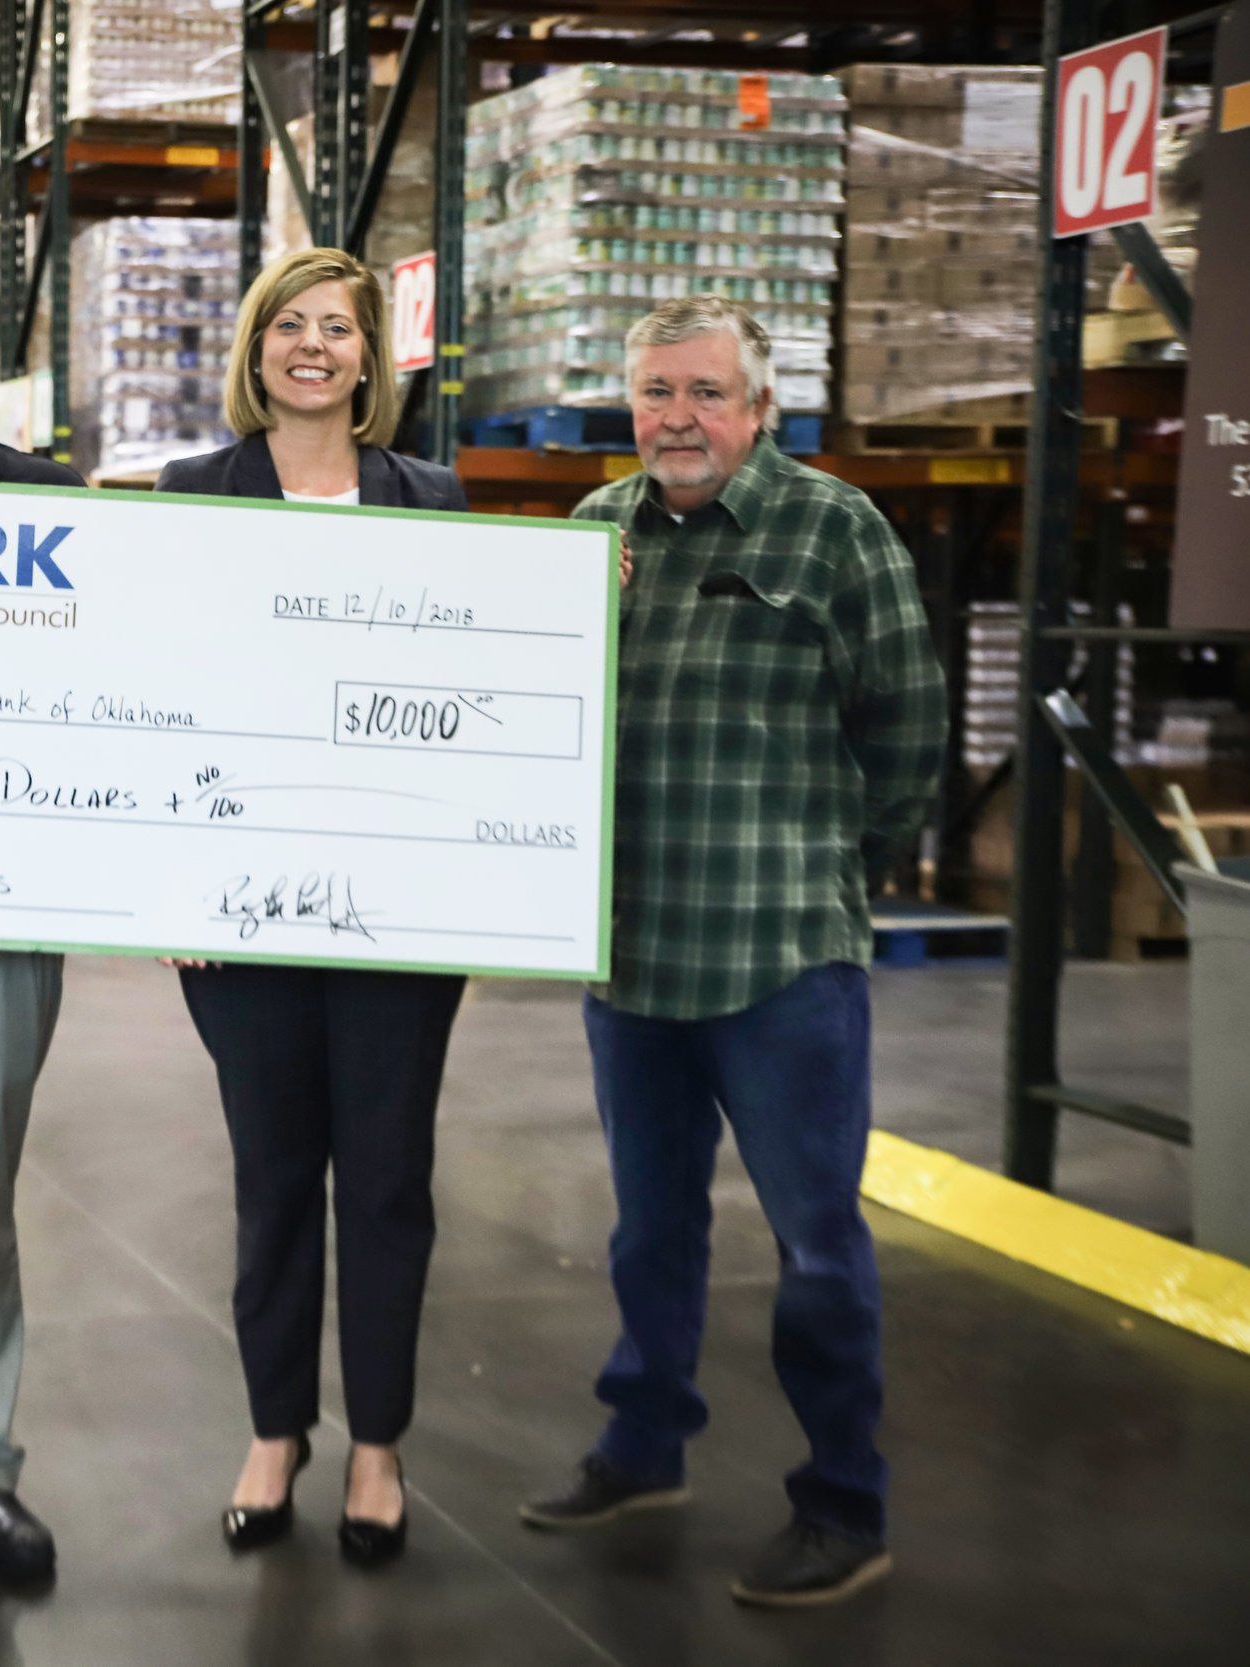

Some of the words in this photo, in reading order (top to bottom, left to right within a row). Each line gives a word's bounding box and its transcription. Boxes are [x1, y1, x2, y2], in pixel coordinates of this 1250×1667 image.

[1060, 51, 1154, 219] 02
[393, 262, 436, 363] 02
[274, 594, 329, 617] DATE
[50, 690, 75, 724] of
[91, 695, 202, 729] Oklahoma
[345, 692, 460, 741] $10,000
[475, 818, 578, 849] DOLLARS
